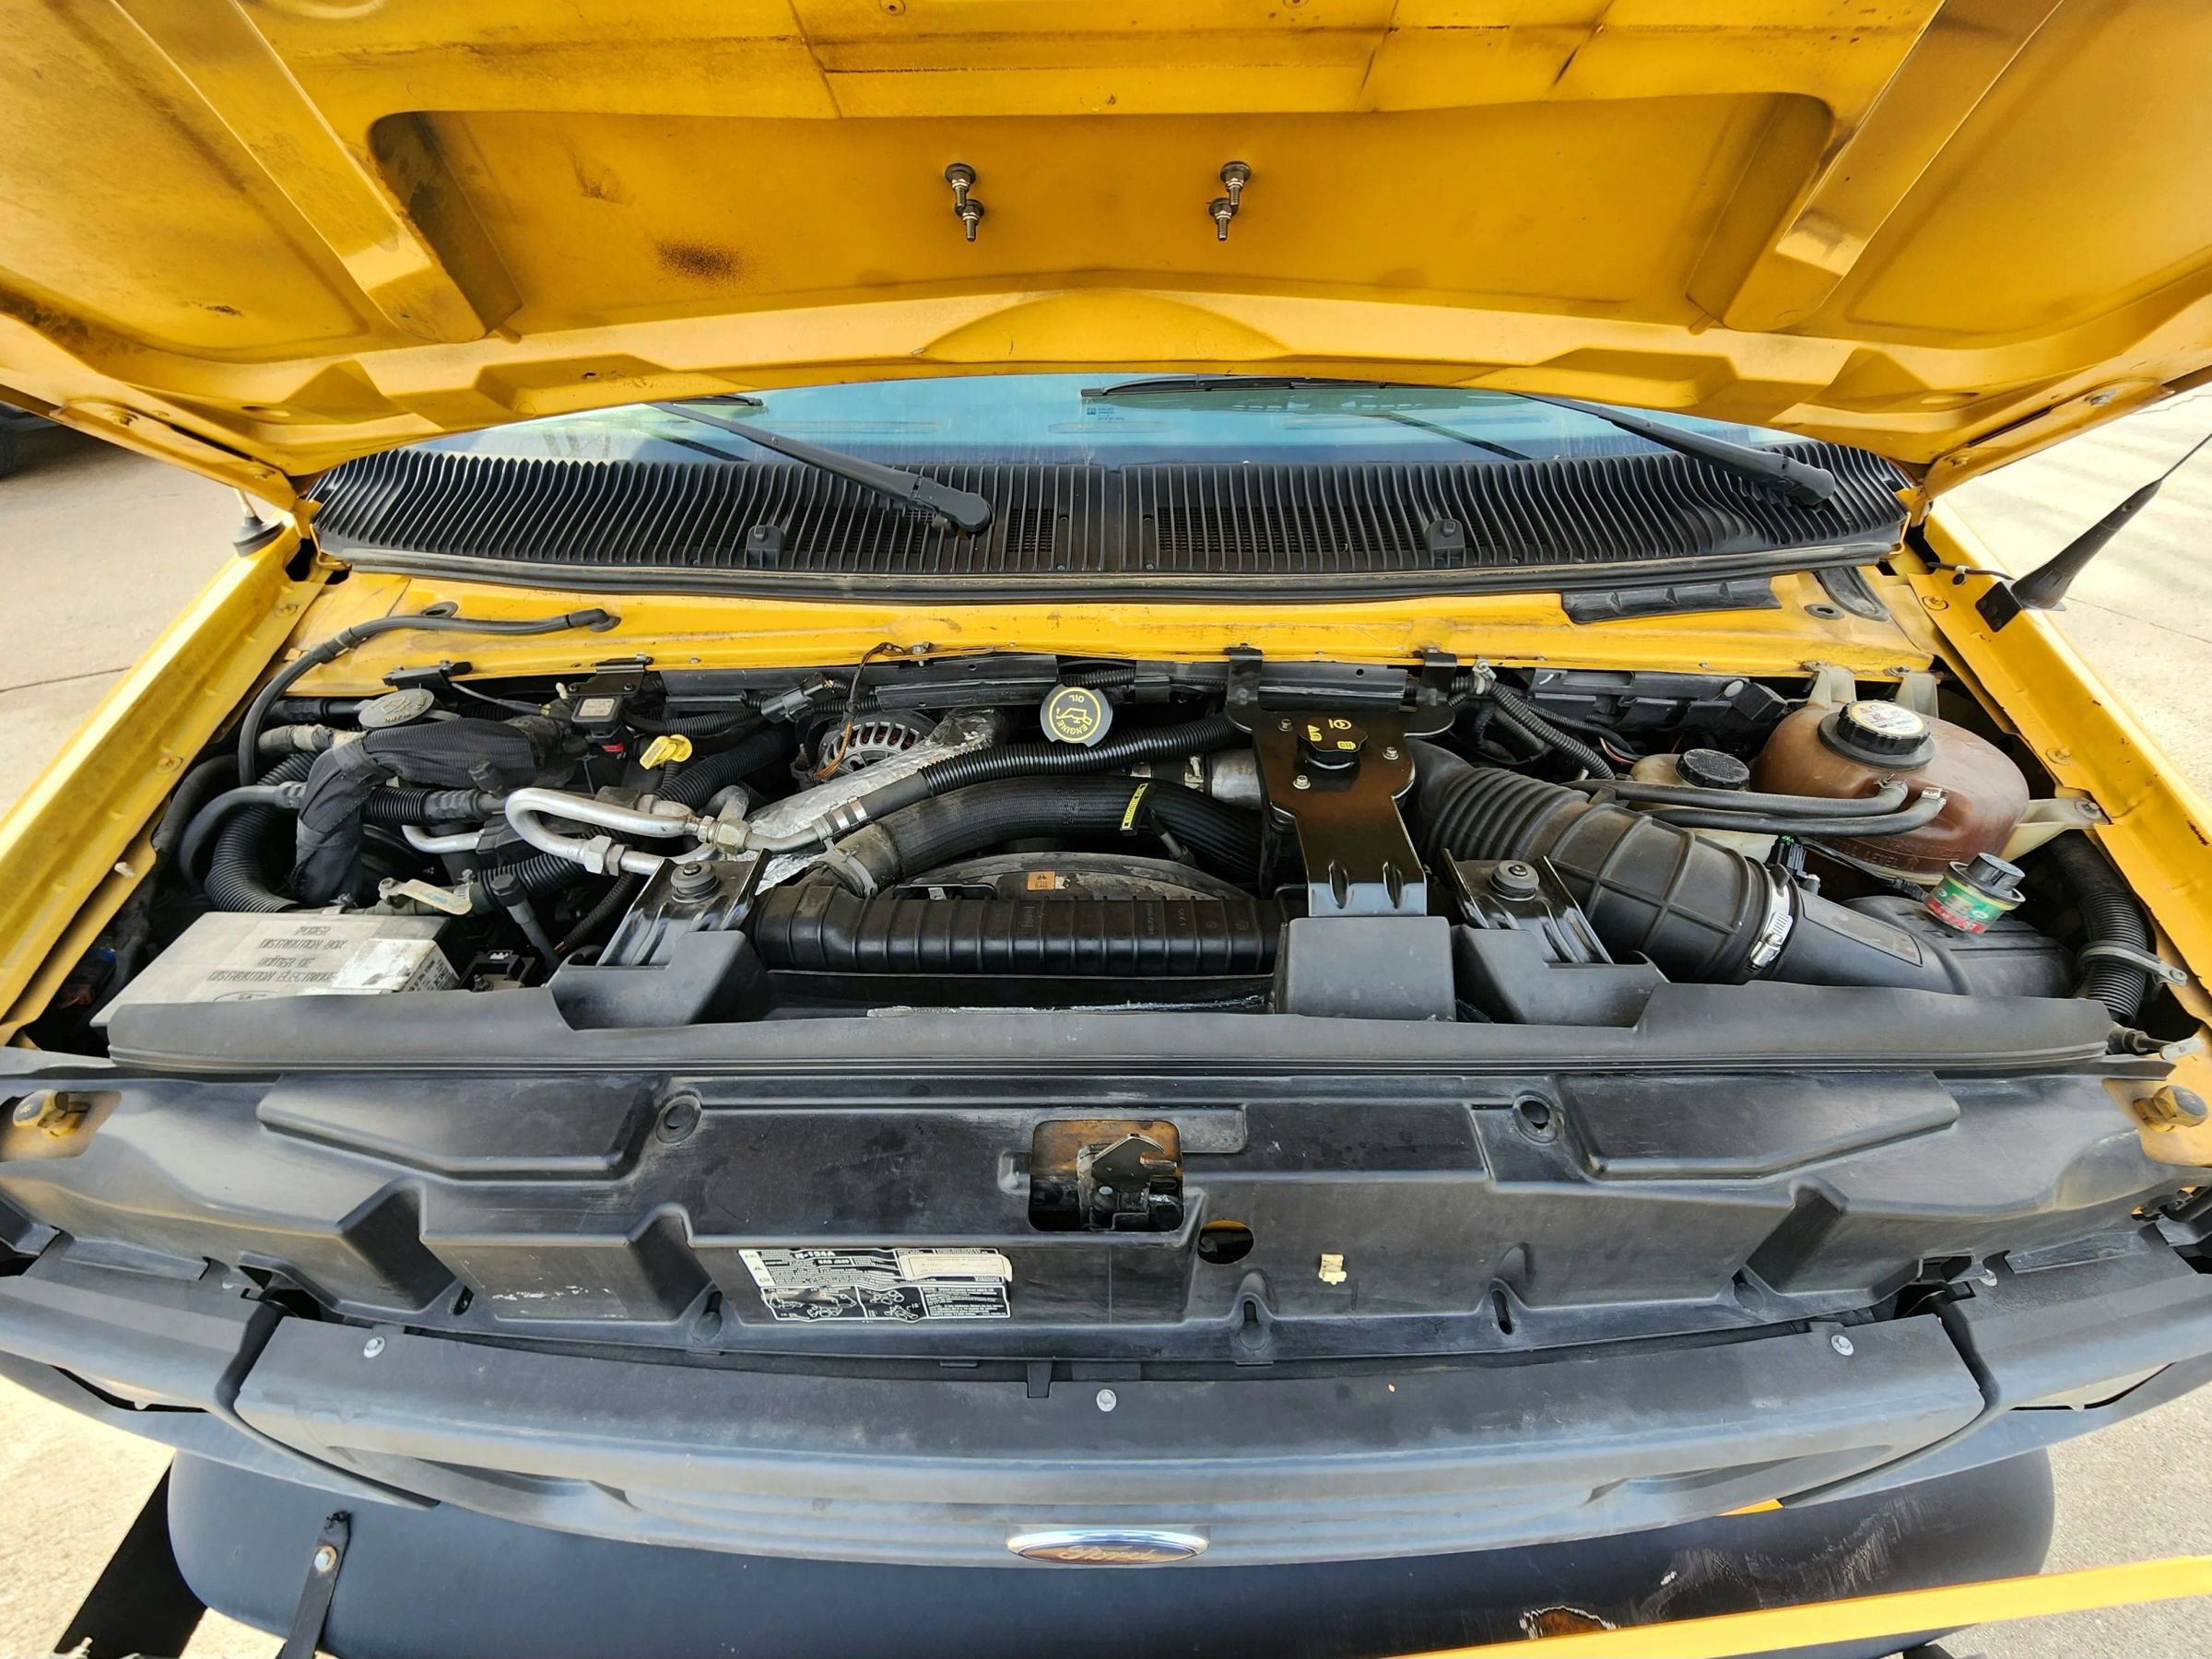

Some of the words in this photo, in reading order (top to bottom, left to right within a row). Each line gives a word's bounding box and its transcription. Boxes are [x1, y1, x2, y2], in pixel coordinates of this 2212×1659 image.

[1069, 694, 1085, 703] OIL
[1056, 719, 1089, 735] ENGINE
[294, 926, 331, 935] POWER
[259, 938, 324, 949] DISTRIBUTION
[324, 938, 348, 949] BOX
[298, 958, 315, 968] DE
[207, 971, 276, 982] DISTRIBUTION
[1058, 1545, 1157, 1562] Ford
